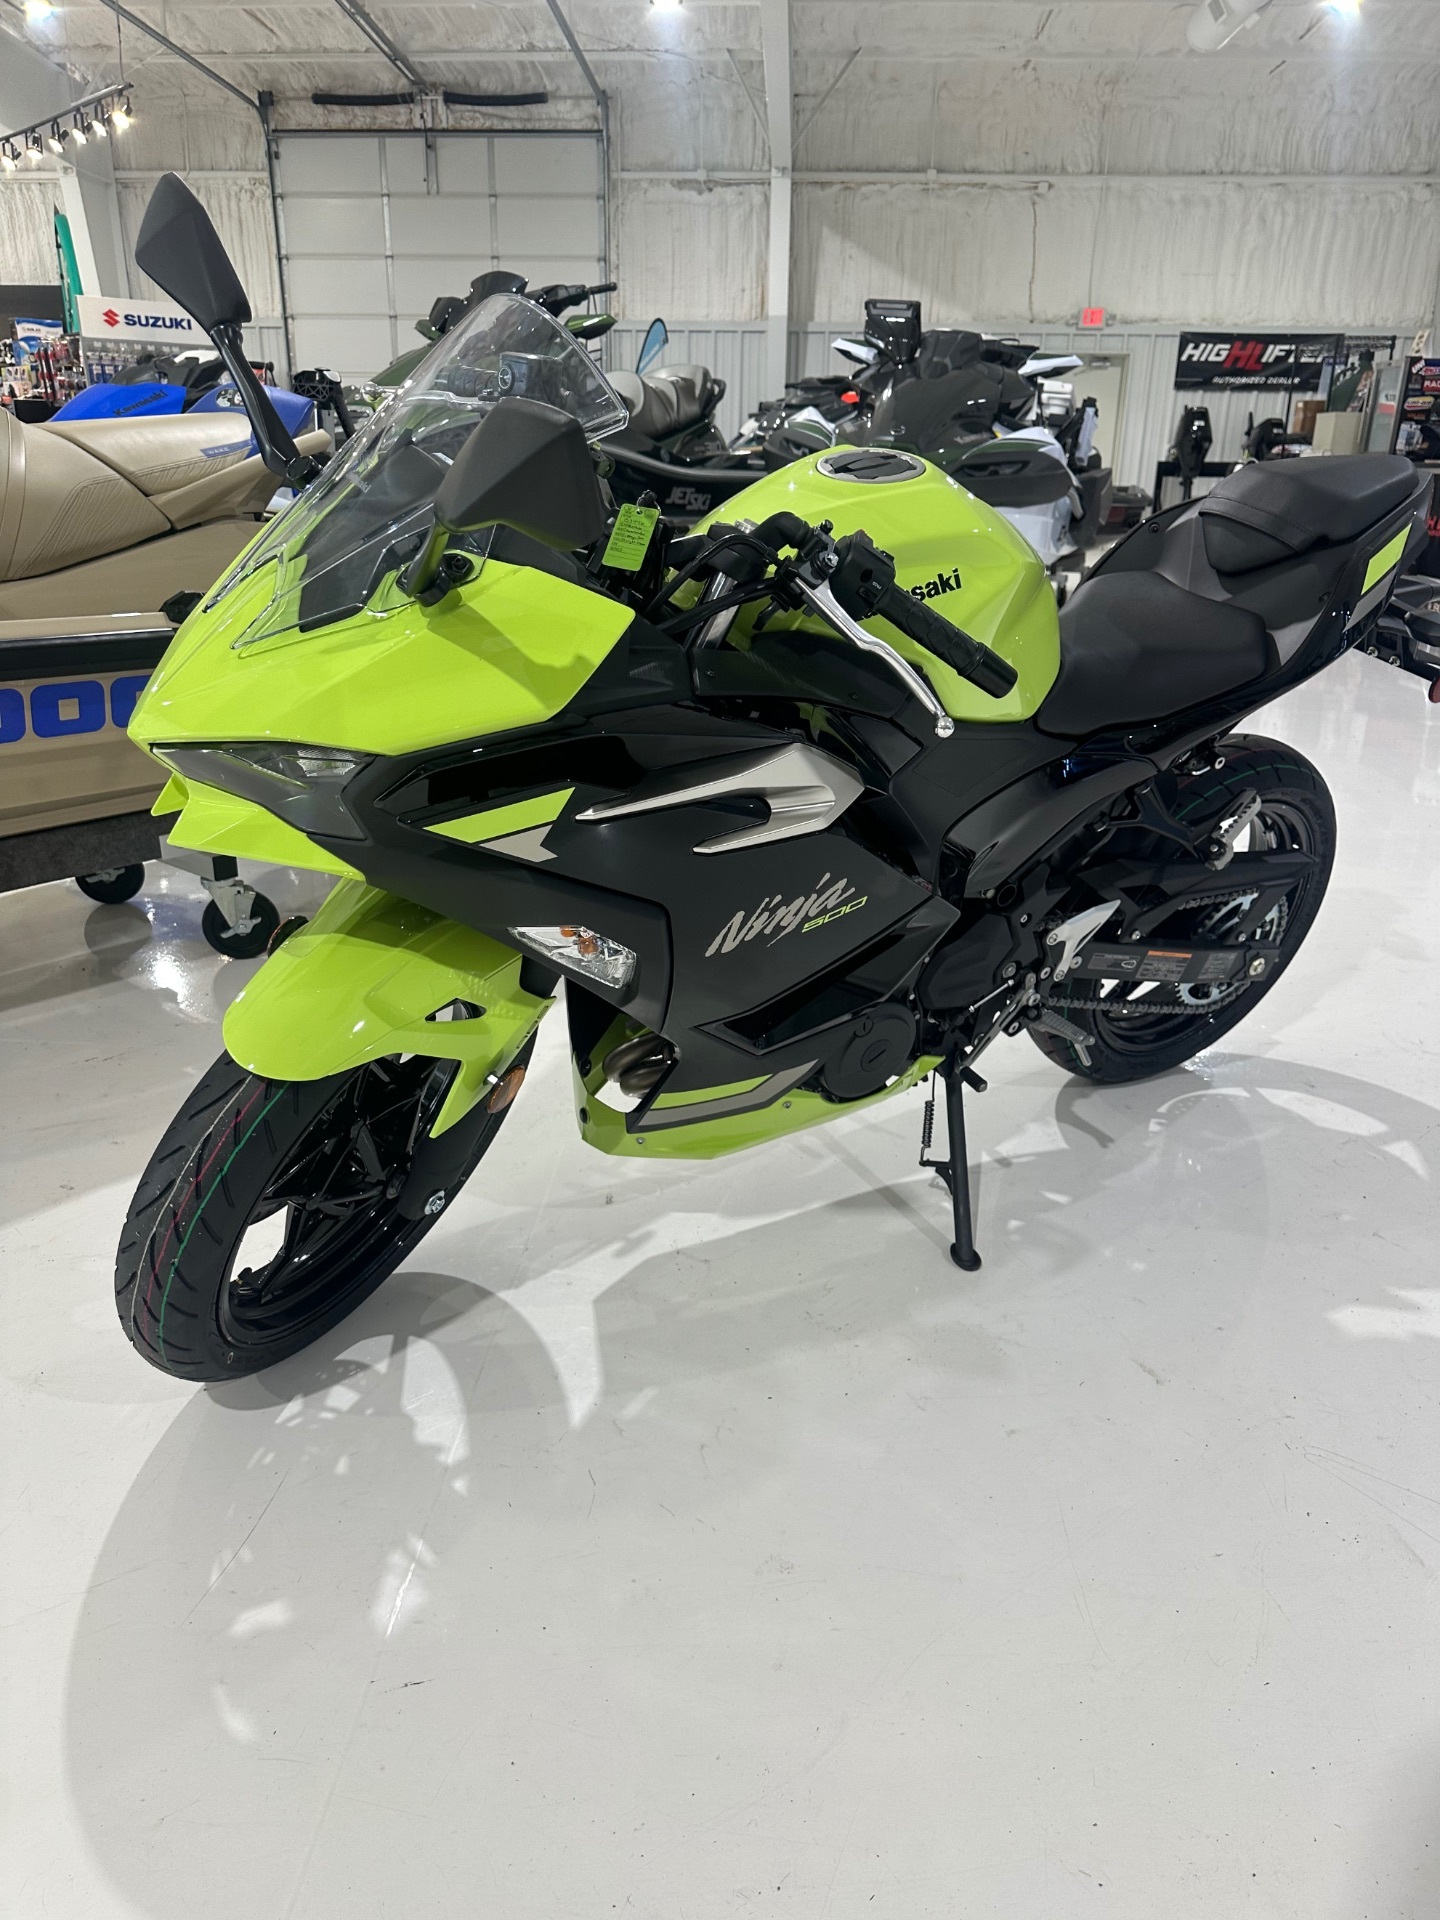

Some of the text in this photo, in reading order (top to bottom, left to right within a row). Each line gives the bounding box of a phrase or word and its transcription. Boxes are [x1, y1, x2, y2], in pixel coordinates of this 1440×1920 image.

[124, 314, 192, 330] SUZUKI
[1212, 376, 1265, 384] AUTHORIZED
[665, 486, 696, 504] JET
[705, 872, 856, 957] Ninja
[802, 896, 868, 933] 500
